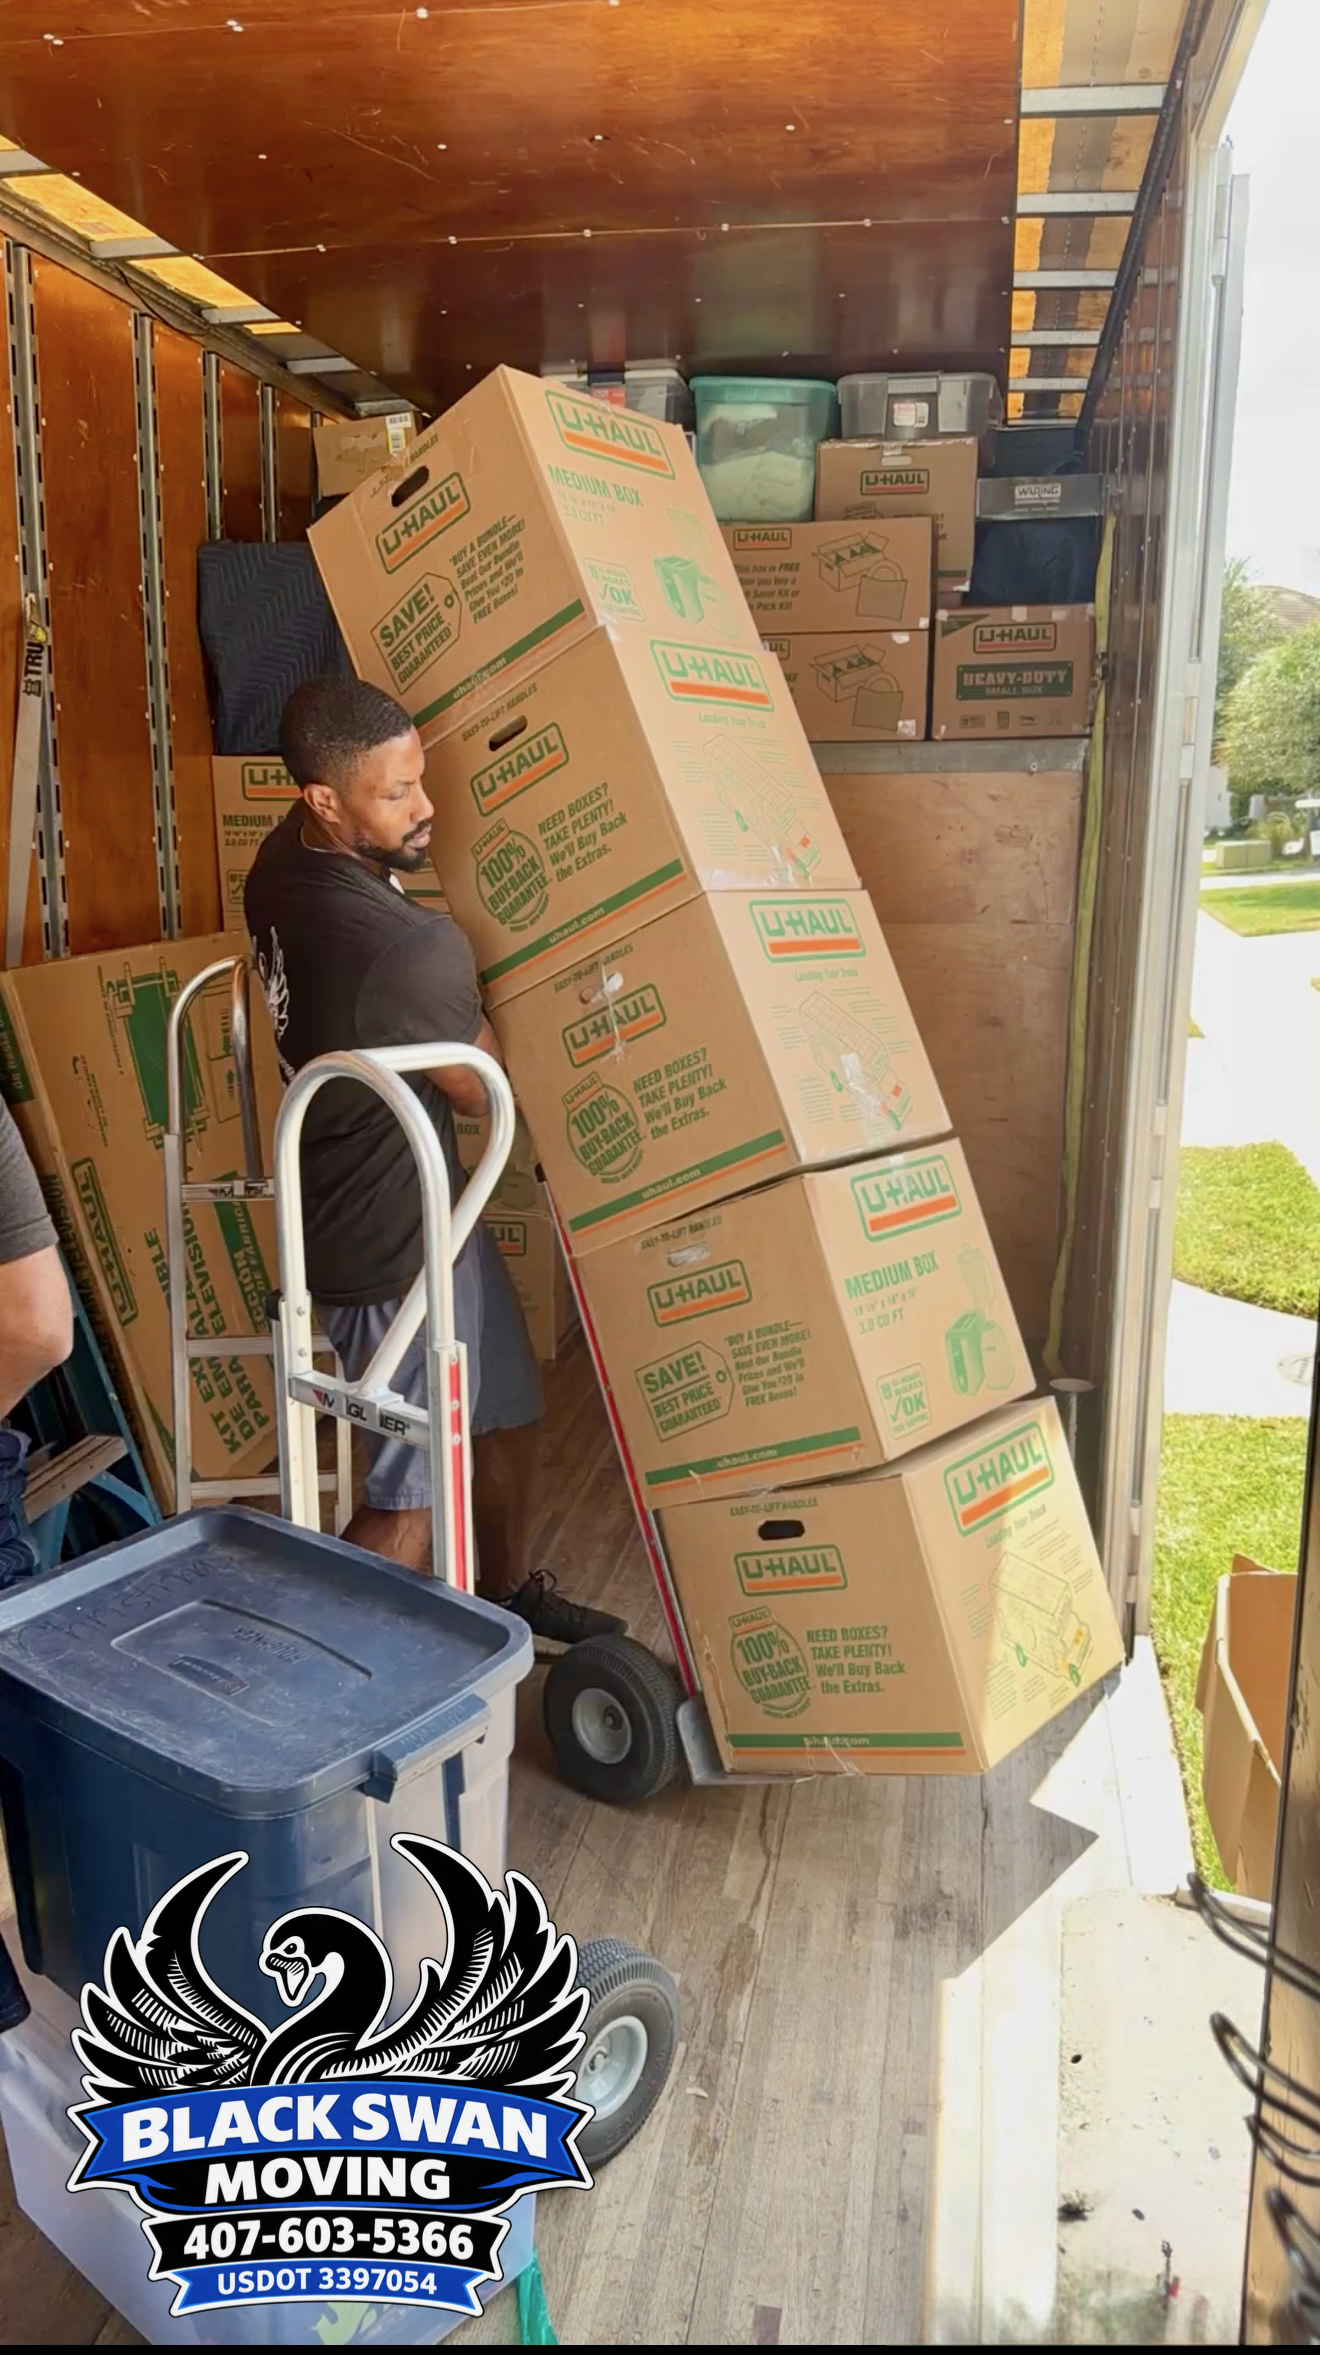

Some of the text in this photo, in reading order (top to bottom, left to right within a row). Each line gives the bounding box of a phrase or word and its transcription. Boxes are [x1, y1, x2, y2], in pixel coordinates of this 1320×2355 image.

[556, 402, 662, 456] U-HAUL
[547, 464, 611, 499] MEDIUM
[613, 483, 644, 507] BOX
[866, 473, 924, 485] U-HAUL
[382, 480, 461, 557] U-HAUL
[737, 531, 788, 542] U-HAUL
[457, 518, 525, 578] SAVE EVEN MORE!
[778, 562, 800, 572] FREE
[609, 586, 637, 607] OK
[757, 578, 771, 587] you
[380, 582, 435, 648] SAVE!
[473, 602, 492, 624] FREE
[391, 611, 445, 671] BEST PRICE
[979, 628, 1051, 642] U-HAUL
[661, 650, 762, 689] U-HAUL
[963, 670, 1067, 686] HEAVY-DUTY
[506, 683, 537, 711] HANDLES
[249, 769, 294, 786] U-H
[477, 734, 560, 798] U-HAUL
[222, 814, 273, 827] MEDIUM
[538, 783, 609, 836] NEED BOXES?
[543, 799, 615, 851] TAKE PLENTY!
[549, 812, 628, 866] We'll Buy Back
[480, 838, 526, 888] 100%
[555, 845, 612, 883] the Extras.
[488, 856, 541, 911] BUY-BACK
[549, 907, 605, 944] uhaul.com
[759, 908, 853, 937] U-HAUL
[568, 994, 656, 1050] U-HAUL
[633, 1047, 707, 1093] NEED BOXES?
[639, 1065, 713, 1109] TAKE PLENTY!
[571, 1092, 621, 1137] 100%
[644, 1078, 727, 1124] We'll Buy Back
[578, 1110, 635, 1160] BUY-BACK
[650, 1108, 710, 1141] the Extras.
[642, 1167, 702, 1200] uhaul.com
[860, 1167, 950, 1213] U-HAUL
[79, 1170, 132, 1315] U-HAUL
[183, 1202, 228, 1336] ELEVISIO
[844, 1250, 939, 1299] MEDIUM BOX
[654, 1268, 742, 1309] U-HAUL
[859, 1308, 904, 1335] 3.0 CU FT
[731, 1343, 753, 1360] SAVE
[755, 1338, 778, 1353] EVEN
[228, 1355, 270, 1427] PARA
[643, 1350, 706, 1394] SAVE!
[653, 1382, 714, 1418] BEST PRICE
[901, 1390, 926, 1417] OK
[211, 1410, 242, 1454] KIT
[228, 1403, 255, 1441] DE
[717, 1448, 778, 1468] uhaul.com
[953, 1437, 1043, 1505] U-HAUL
[742, 1555, 837, 1579] U-HAUL
[732, 1608, 769, 1627] U-HAUL
[806, 1626, 888, 1643] NEED BOXES?
[737, 1630, 790, 1664] 100%
[810, 1643, 892, 1660] TAKE PLENTY!
[742, 1656, 804, 1687] BUY-BACK
[815, 1661, 905, 1678] We'll Buy Back
[820, 1678, 885, 1695] the Extras.
